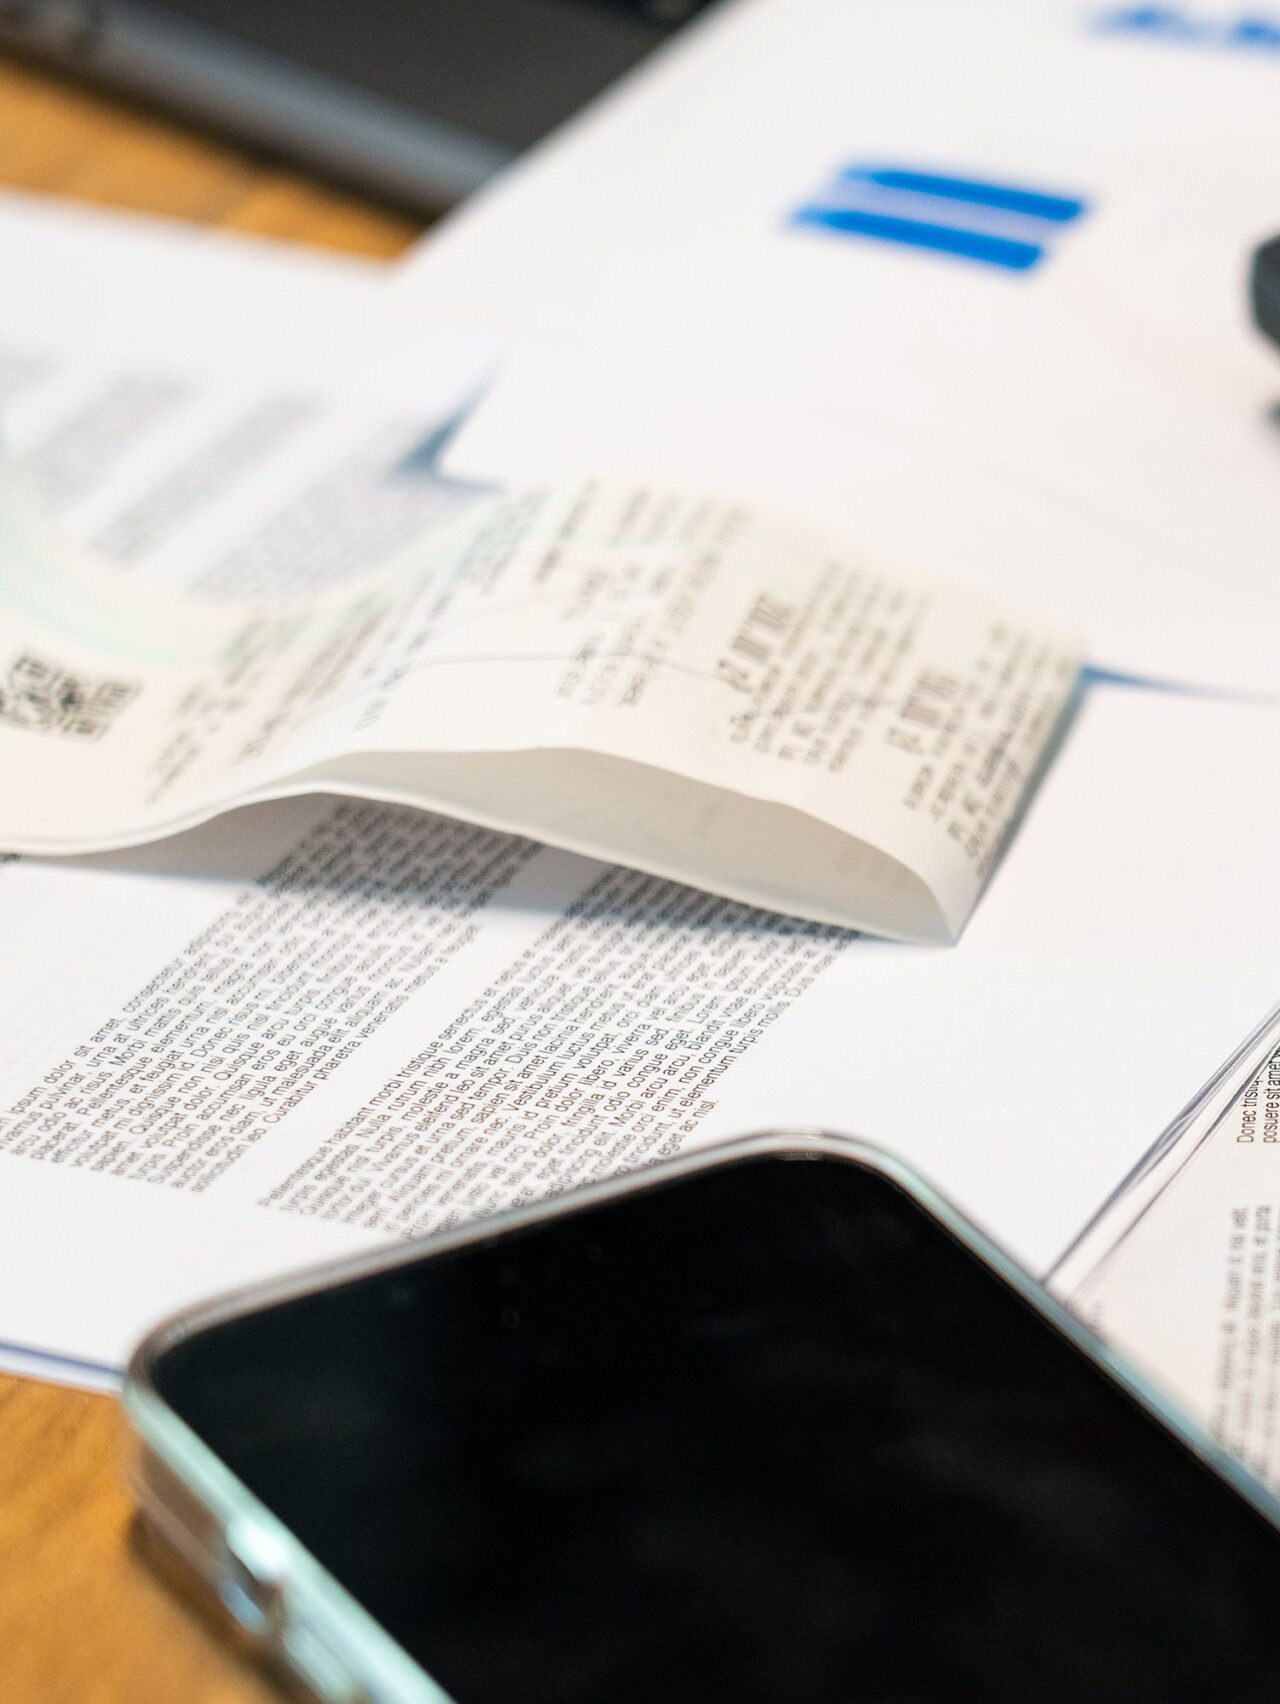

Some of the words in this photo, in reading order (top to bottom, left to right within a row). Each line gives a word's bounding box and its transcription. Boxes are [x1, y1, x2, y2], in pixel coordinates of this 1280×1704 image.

[42, 1059, 76, 1084] dolor
[72, 1044, 94, 1058] sit
[107, 1038, 147, 1066] Morbi
[127, 1072, 183, 1116] dignissim
[189, 1026, 233, 1058] Donec
[128, 1082, 147, 1094] et
[138, 1049, 184, 1082] feugiat
[179, 1025, 210, 1048] urna
[176, 1074, 205, 1094] non
[199, 1054, 226, 1073] nisi
[221, 1032, 250, 1054] quis
[195, 1072, 254, 1120] accumsan
[250, 1048, 281, 1071] eros
[276, 1033, 296, 1047] eu
[212, 1041, 264, 1081] Quisque
[259, 1095, 277, 1107] ut
[271, 1044, 334, 1095] malesuada
[262, 1080, 317, 1123] Curabitur
[312, 1040, 361, 1080] pharetra
[368, 1078, 404, 1106] morbi
[395, 1040, 443, 1078] tristique
[400, 1081, 448, 1121] molestie
[444, 1071, 460, 1080] a
[454, 1037, 495, 1070] magna
[449, 1100, 476, 1120] sed
[503, 1041, 537, 1064] Duis
[602, 1090, 630, 1112] odio
[626, 1052, 668, 1088] congue
[677, 1064, 704, 1084] non
[697, 1029, 739, 1064] congue
[76, 1056, 152, 1116] Pellentesque
[218, 1102, 246, 1121] nec
[238, 1074, 277, 1100] ligula
[273, 1049, 303, 1072] eget
[386, 1079, 427, 1111] rutrum
[421, 1054, 451, 1078] nibh
[413, 1093, 459, 1131] eleifend
[448, 1078, 475, 1094] leo
[469, 1065, 490, 1078] sit
[482, 1040, 514, 1066] amet
[469, 1091, 510, 1124] sapien
[500, 1078, 523, 1092] sit
[516, 1054, 548, 1079] amet
[502, 1060, 565, 1111] Vestibulum
[521, 1109, 539, 1121] id
[534, 1072, 578, 1109] pretium
[547, 1087, 585, 1112] dolor
[559, 1092, 605, 1127] fringilla
[596, 1079, 617, 1091] id
[612, 1048, 649, 1077] varius
[607, 1099, 645, 1127] Morbi
[639, 1076, 668, 1099] arcu
[667, 1107, 686, 1119] ut
[679, 1054, 736, 1107] elementum
[1264, 1088, 1280, 1099] sit
[678, 1118, 698, 1132] ac
[1237, 1111, 1256, 1142] Donec
[1263, 1103, 1280, 1143] posuere
